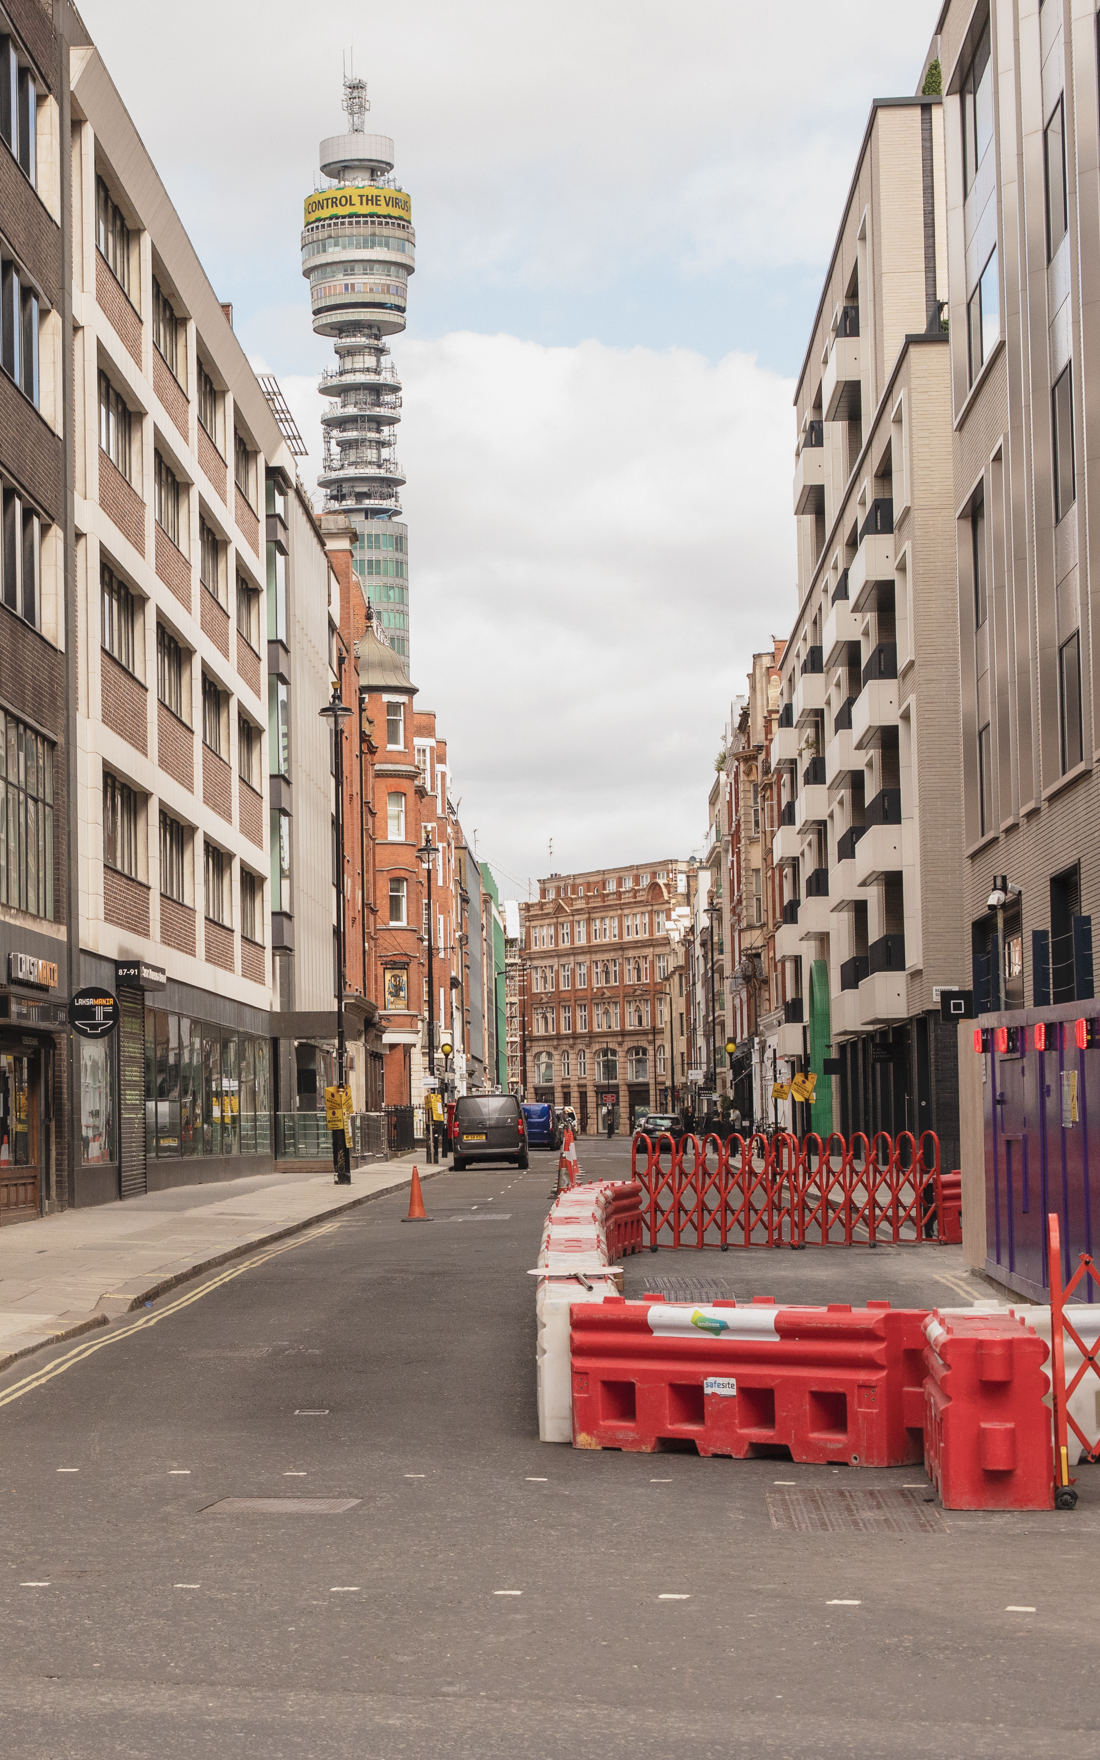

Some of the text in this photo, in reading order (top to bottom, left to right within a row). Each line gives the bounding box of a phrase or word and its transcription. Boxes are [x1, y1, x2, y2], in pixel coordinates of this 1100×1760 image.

[307, 194, 409, 214] CONTROL THE VIRUS
[118, 968, 138, 976] 87-91
[74, 998, 114, 1006] LAKSAMANIA
[705, 1381, 735, 1389] safesite
